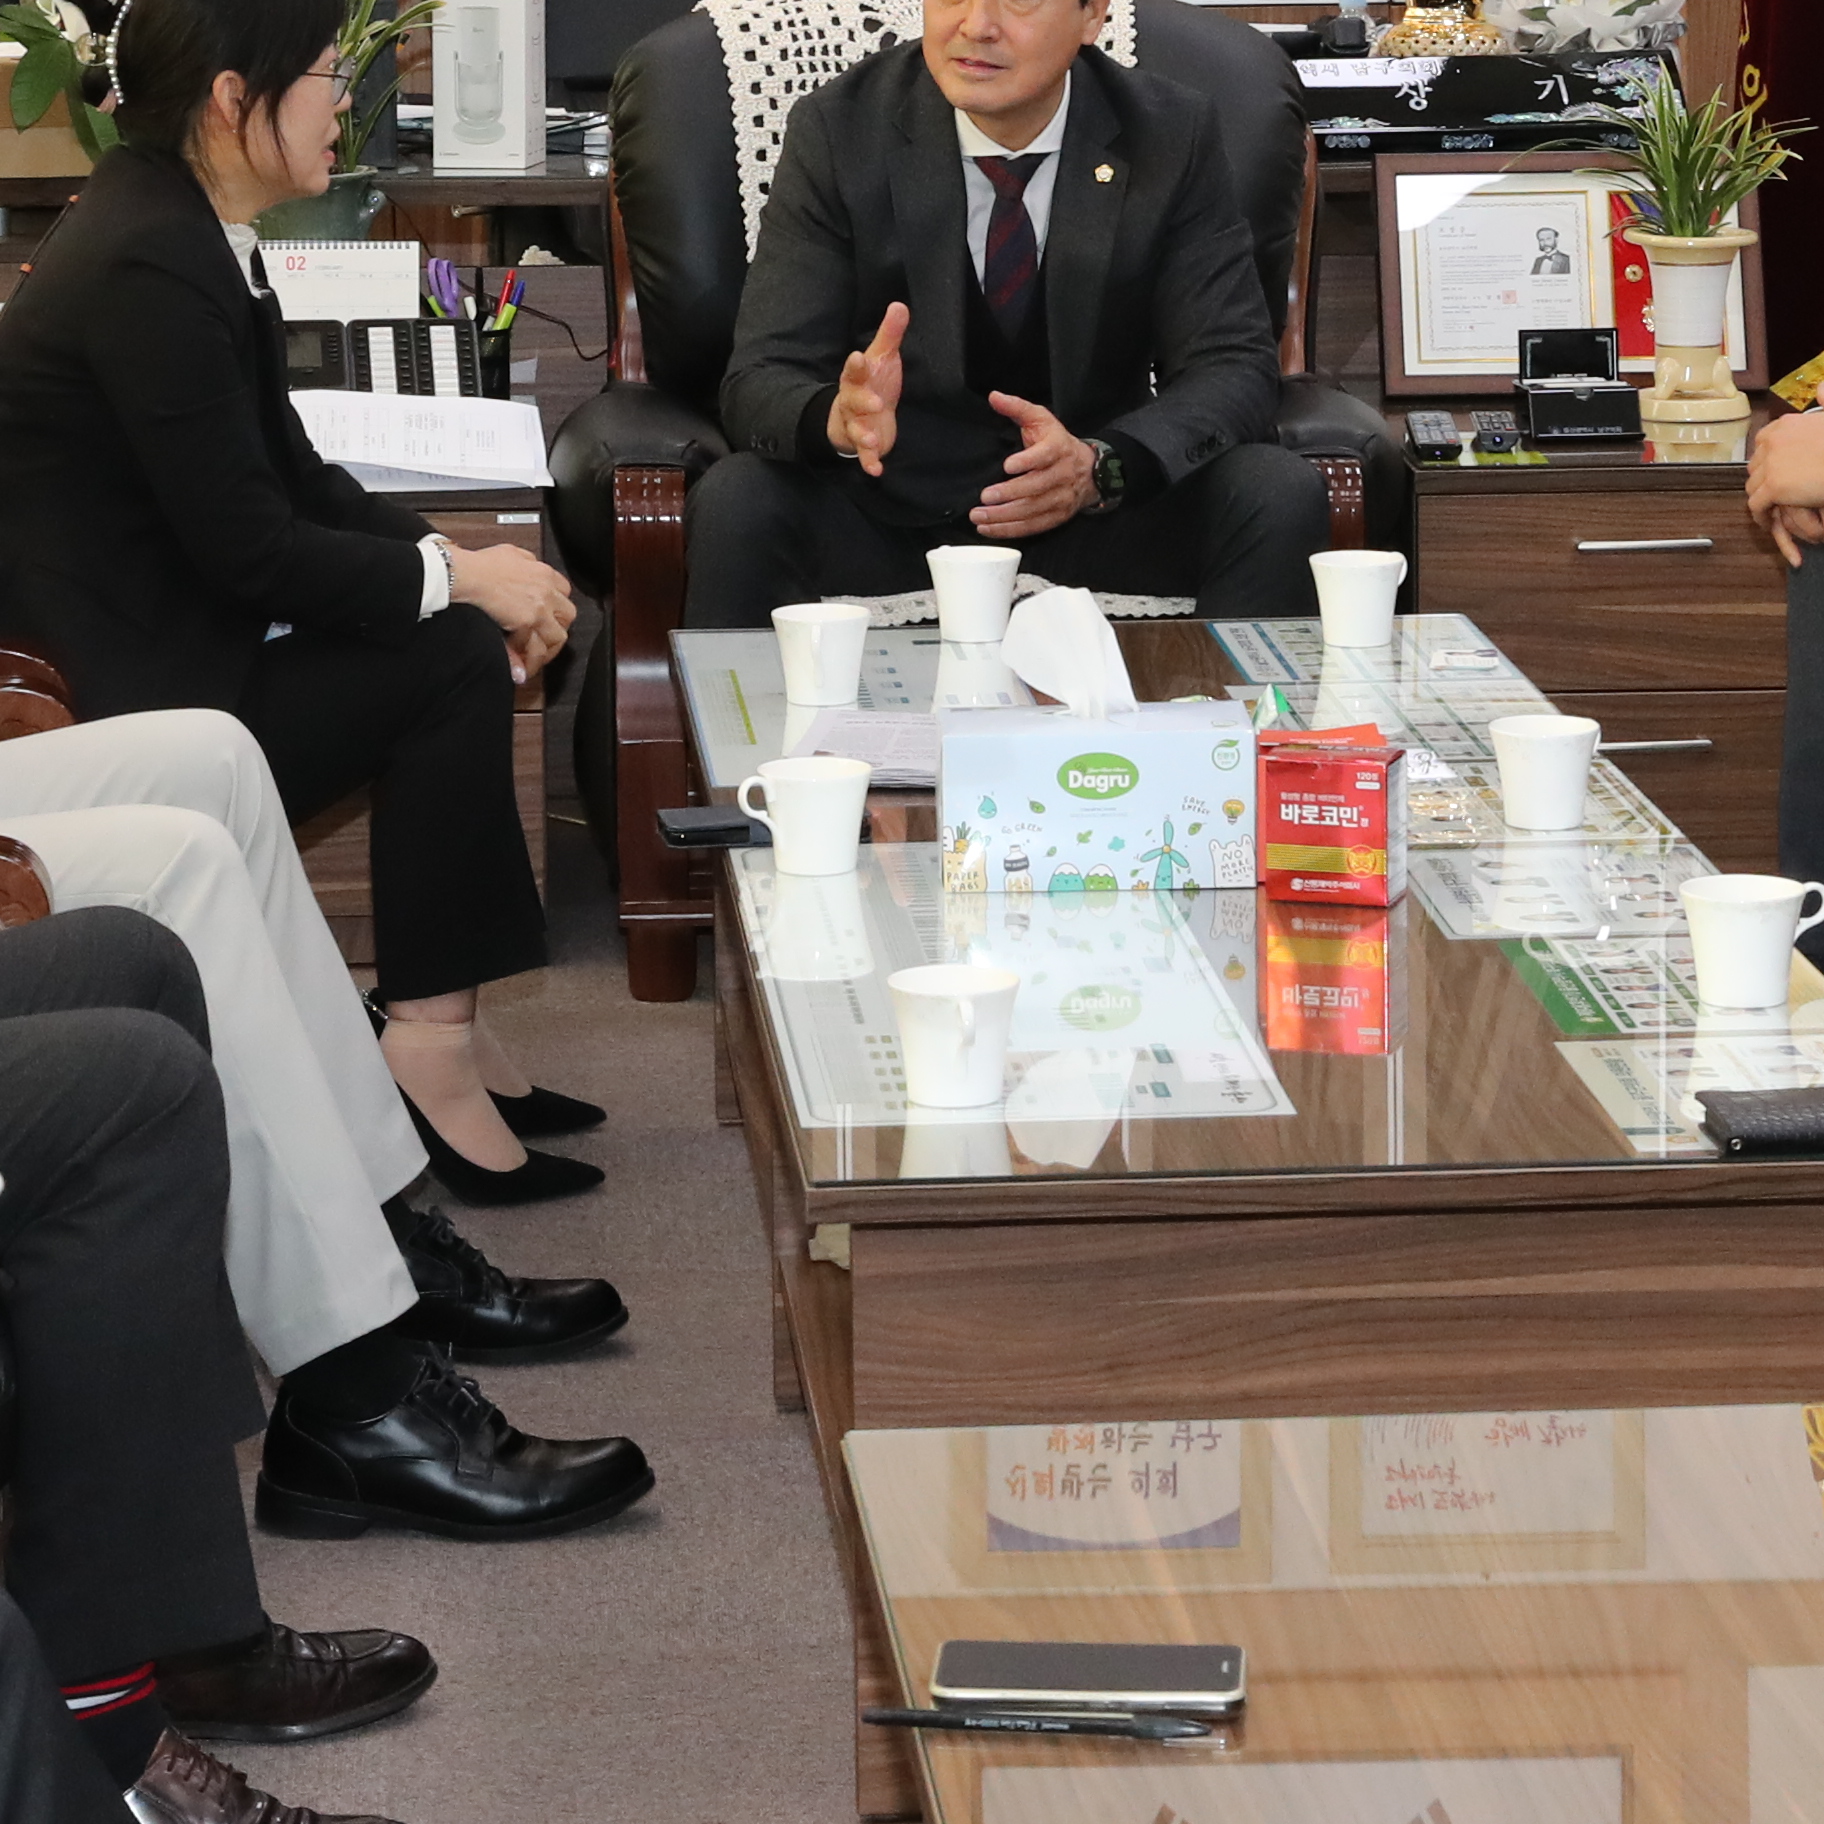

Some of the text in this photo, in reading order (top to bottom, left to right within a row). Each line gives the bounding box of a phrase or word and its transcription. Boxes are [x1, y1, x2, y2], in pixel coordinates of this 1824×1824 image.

[1395, 75, 1571, 112] 상 기
[285, 255, 307, 271] 02
[1068, 769, 1131, 793] Dagru
[1183, 795, 1206, 807] SAVE
[1182, 803, 1211, 815] ENERGY
[1280, 803, 1359, 828] 바로코민
[1001, 822, 1043, 834] GO GREEN
[1222, 849, 1243, 861] NO
[1220, 858, 1251, 871] MORE
[946, 871, 980, 883] PAPER
[951, 880, 980, 893] BAGS
